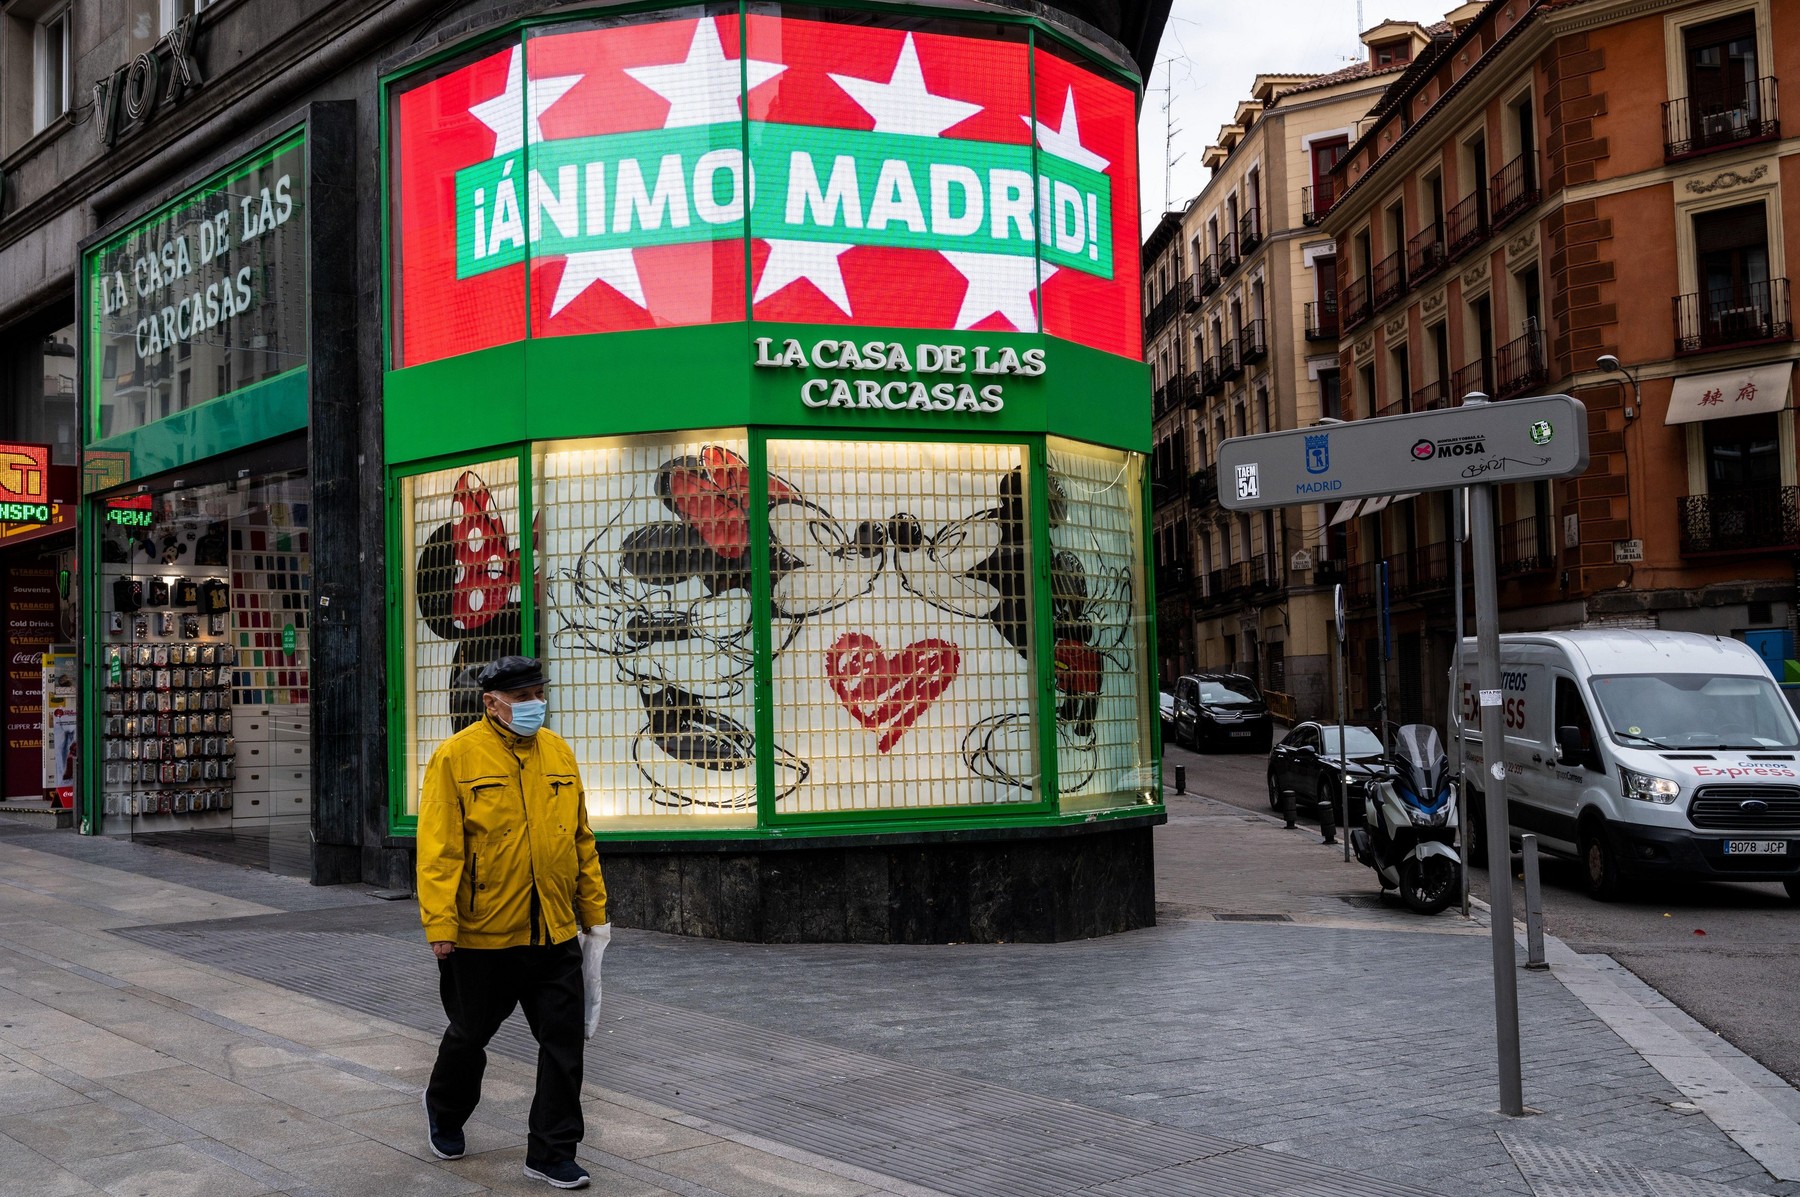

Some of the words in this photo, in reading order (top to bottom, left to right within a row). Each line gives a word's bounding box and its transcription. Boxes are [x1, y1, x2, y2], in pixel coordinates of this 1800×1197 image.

[92, 13, 203, 147] VOX
[473, 148, 756, 260] ¡ÁNIMO
[784, 151, 1098, 261] MADRID!
[101, 270, 129, 316] LA
[134, 235, 192, 298] CASA
[200, 209, 230, 265] DE
[240, 174, 293, 243] LAS
[135, 265, 251, 359] CARCASAS
[753, 337, 809, 368] LA
[811, 339, 913, 373] CASA
[916, 344, 966, 374] DE
[971, 346, 1047, 377] LAS
[801, 379, 1004, 413] CARCASAS
[1437, 441, 1485, 458] MOSA
[1237, 465, 1256, 478] TAEM
[1238, 476, 1257, 498] 54
[1296, 480, 1342, 495] MADRID
[1500, 671, 1528, 691] rreos
[1693, 765, 1796, 779] Express
[1730, 842, 1757, 853] 9078
[1763, 842, 1785, 853] JCP
